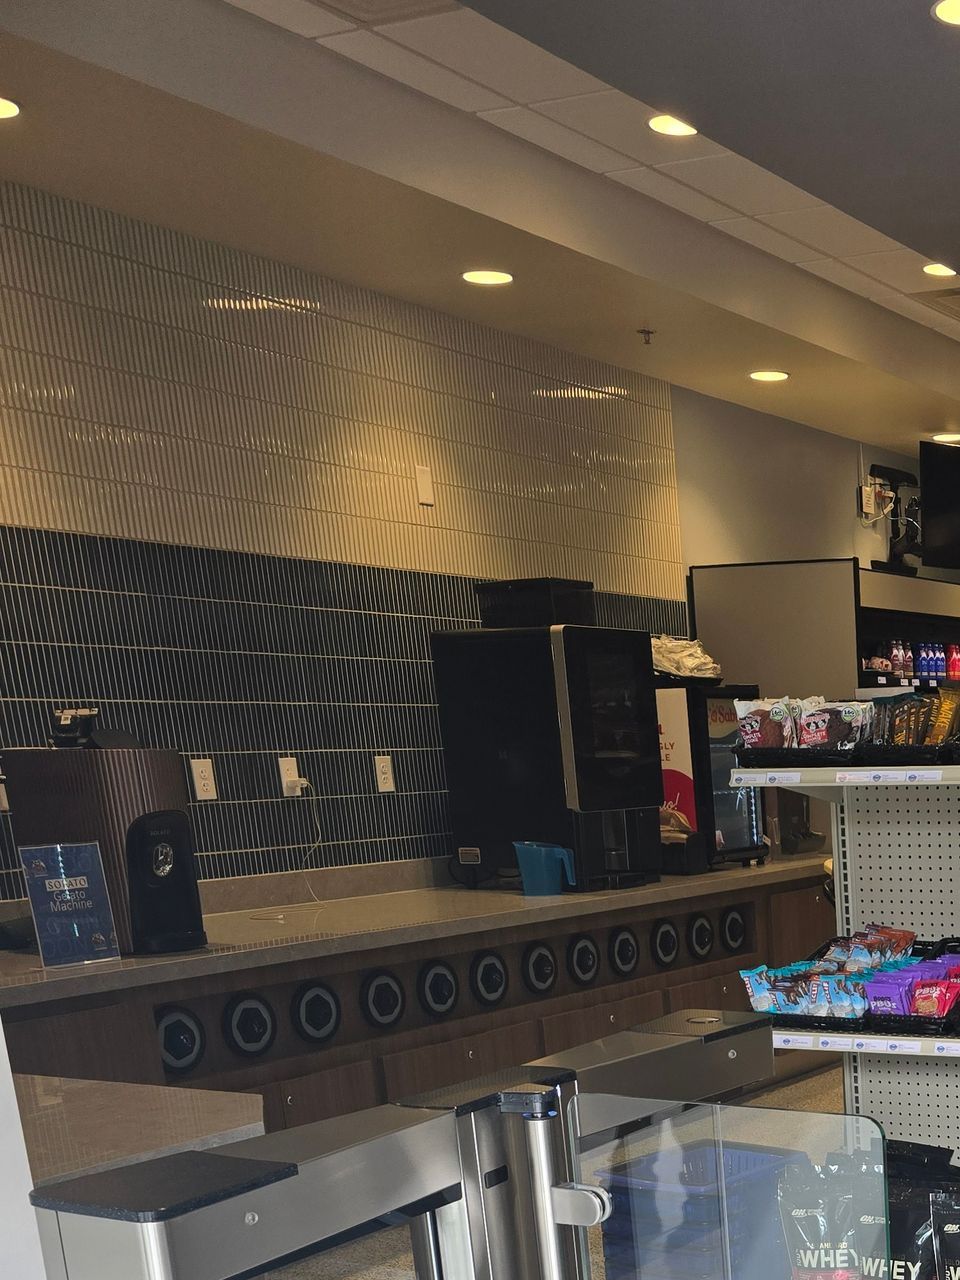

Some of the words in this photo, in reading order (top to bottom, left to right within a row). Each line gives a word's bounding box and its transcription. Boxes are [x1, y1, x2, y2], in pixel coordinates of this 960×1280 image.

[53, 890, 86, 901] Geato
[50, 900, 93, 912] Machine
[799, 1248, 859, 1268] WHEY
